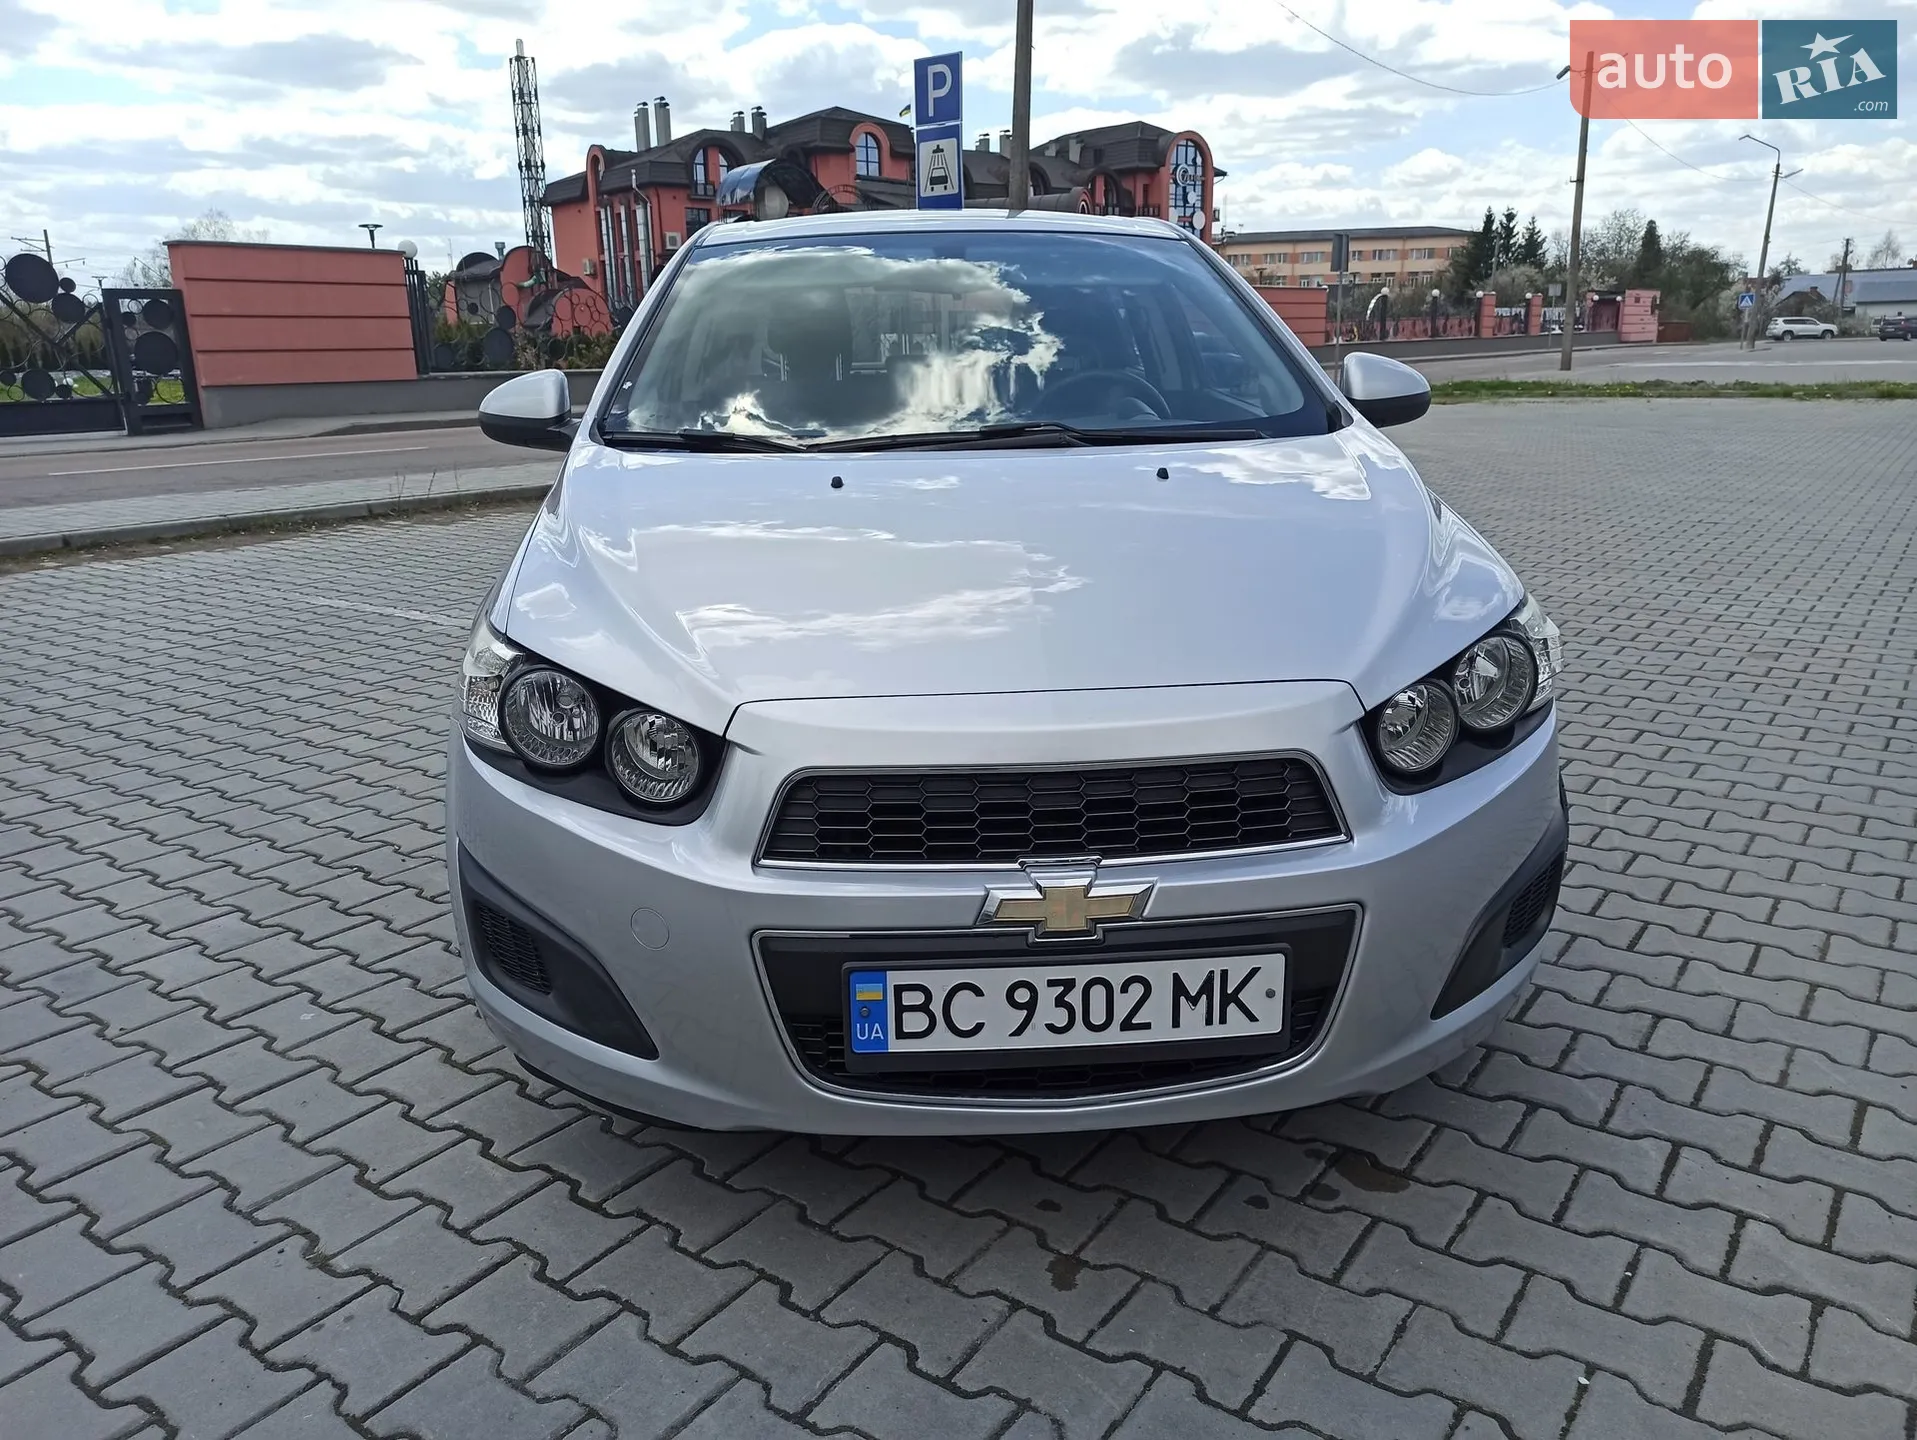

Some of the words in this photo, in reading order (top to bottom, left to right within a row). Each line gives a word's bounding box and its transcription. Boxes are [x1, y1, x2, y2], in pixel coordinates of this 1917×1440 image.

[927, 63, 952, 117] P
[893, 981, 985, 1040] BC
[1004, 974, 1152, 1037] 9302
[1171, 966, 1262, 1029] MK
[856, 1023, 884, 1041] UA
